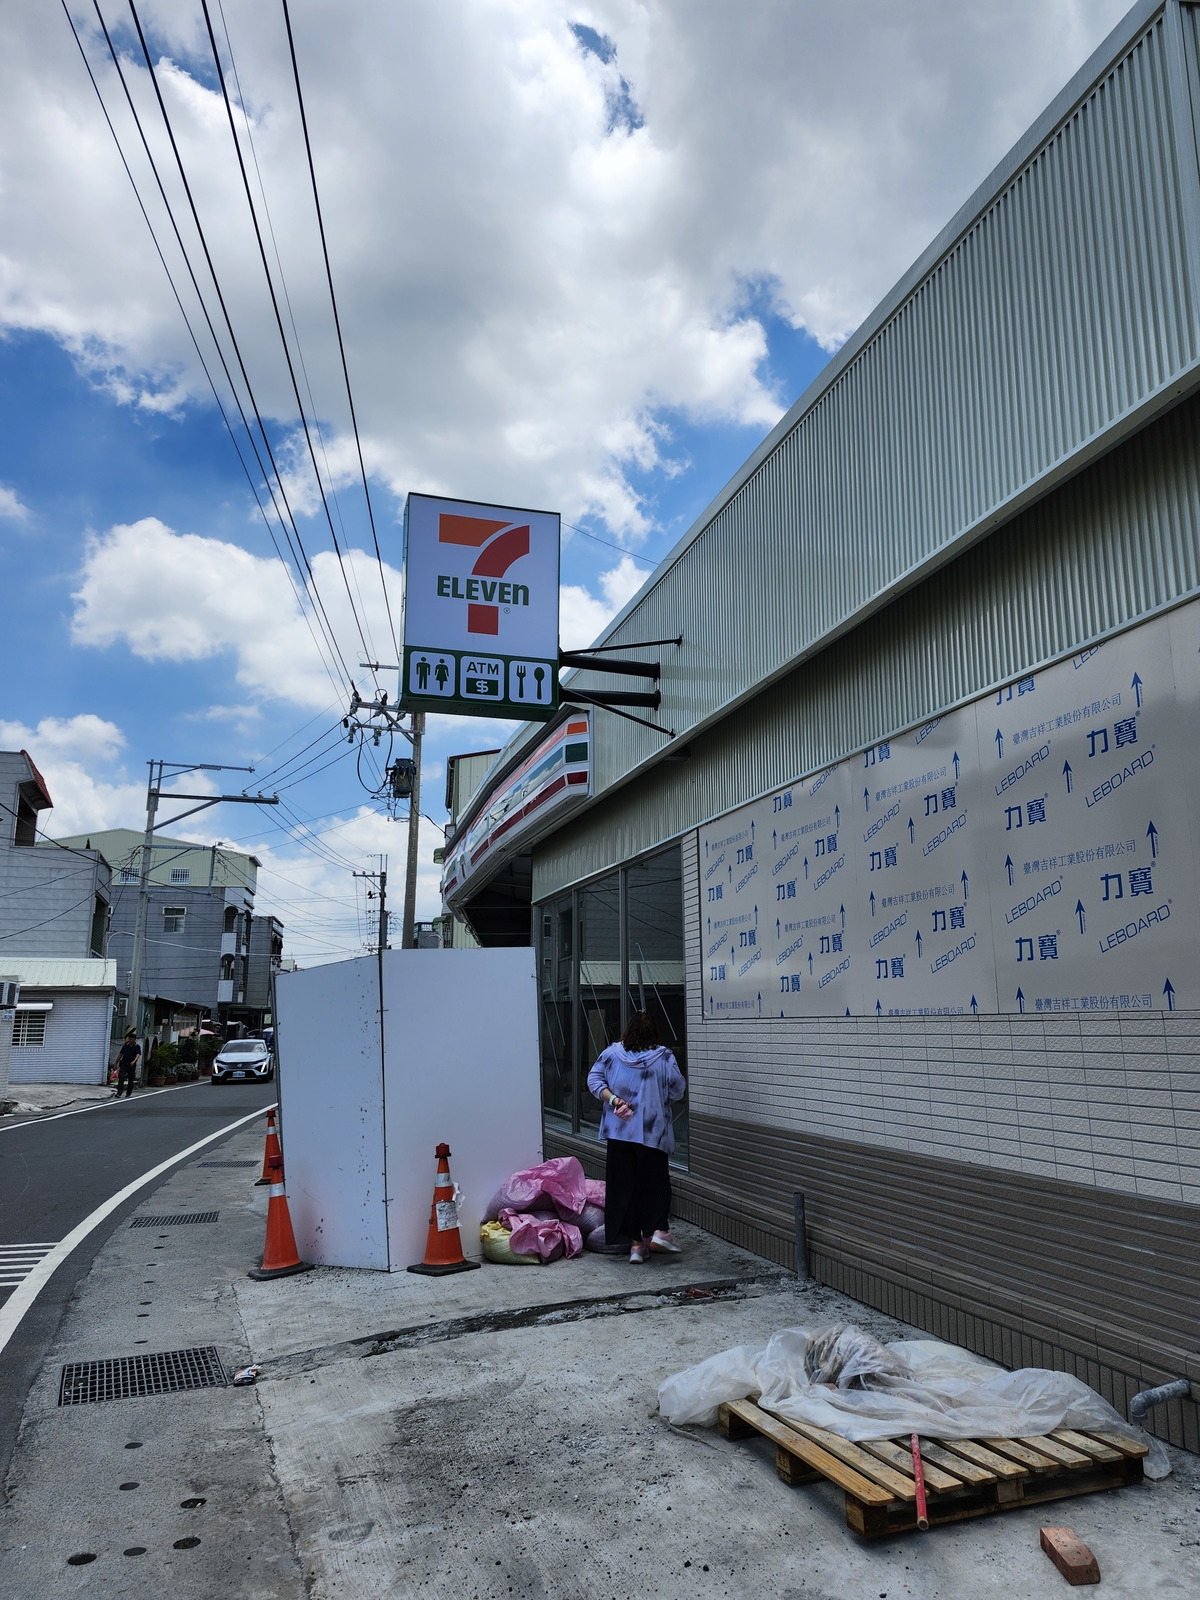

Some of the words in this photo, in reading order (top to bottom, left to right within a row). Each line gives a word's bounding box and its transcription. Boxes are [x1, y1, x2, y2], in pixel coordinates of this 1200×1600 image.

[439, 513, 530, 635] 7
[466, 661, 499, 676] ATM
[1012, 693, 1122, 746] 臺灣吉祥工業股份有限公司
[1086, 717, 1138, 758] 力寶
[994, 744, 1050, 796] LEBOARD
[1085, 750, 1154, 808] LEBOARD
[924, 786, 956, 817] 力寶
[1004, 798, 1046, 831] 力寶
[869, 846, 897, 872] 力寶
[1023, 839, 1136, 875] 臺灣吉祥工業股份有限公司
[1100, 866, 1153, 901] 力寶
[932, 906, 965, 933] 力寶
[1005, 880, 1062, 925] LEBOARD
[1099, 904, 1171, 953] LEBOARD
[1015, 934, 1059, 962] 力寶
[876, 957, 905, 979] 力寶
[1035, 994, 1152, 1011] 臺灣吉祥工業股份有限公司
